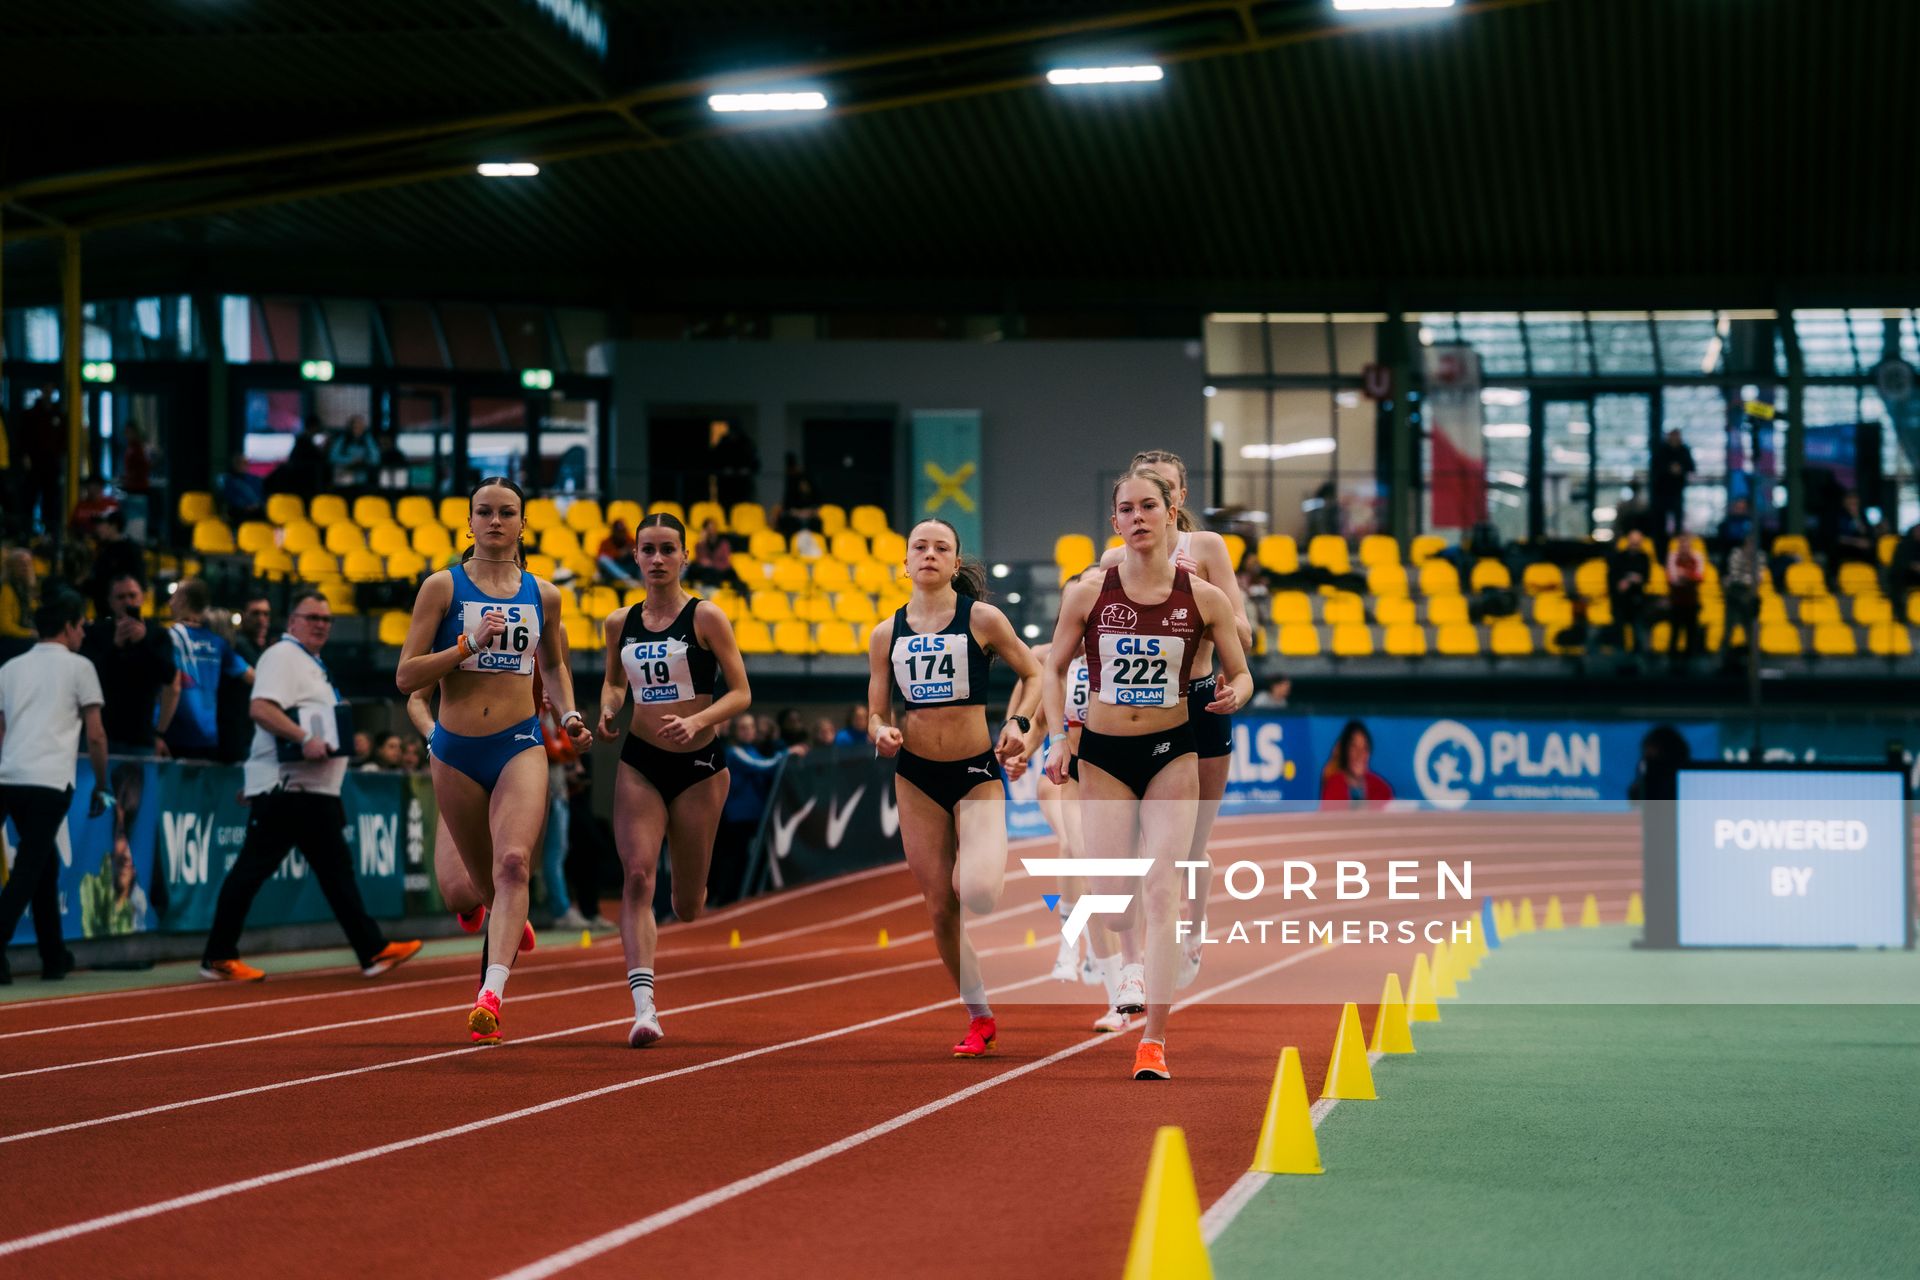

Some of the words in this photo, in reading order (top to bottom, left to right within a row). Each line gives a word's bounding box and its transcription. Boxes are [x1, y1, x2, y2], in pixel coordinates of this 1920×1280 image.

[498, 656, 520, 665] PLAN
[640, 661, 670, 685] 19
[905, 654, 956, 681] 174
[1113, 658, 1168, 685] 222
[655, 688, 676, 696] PLAN
[927, 685, 951, 694] PLAN
[1135, 690, 1163, 699] PLAN
[1229, 722, 1296, 783] LS.
[1490, 731, 1600, 776] PLAN
[1714, 818, 1868, 850] POWERED
[1771, 866, 1814, 896] BY
